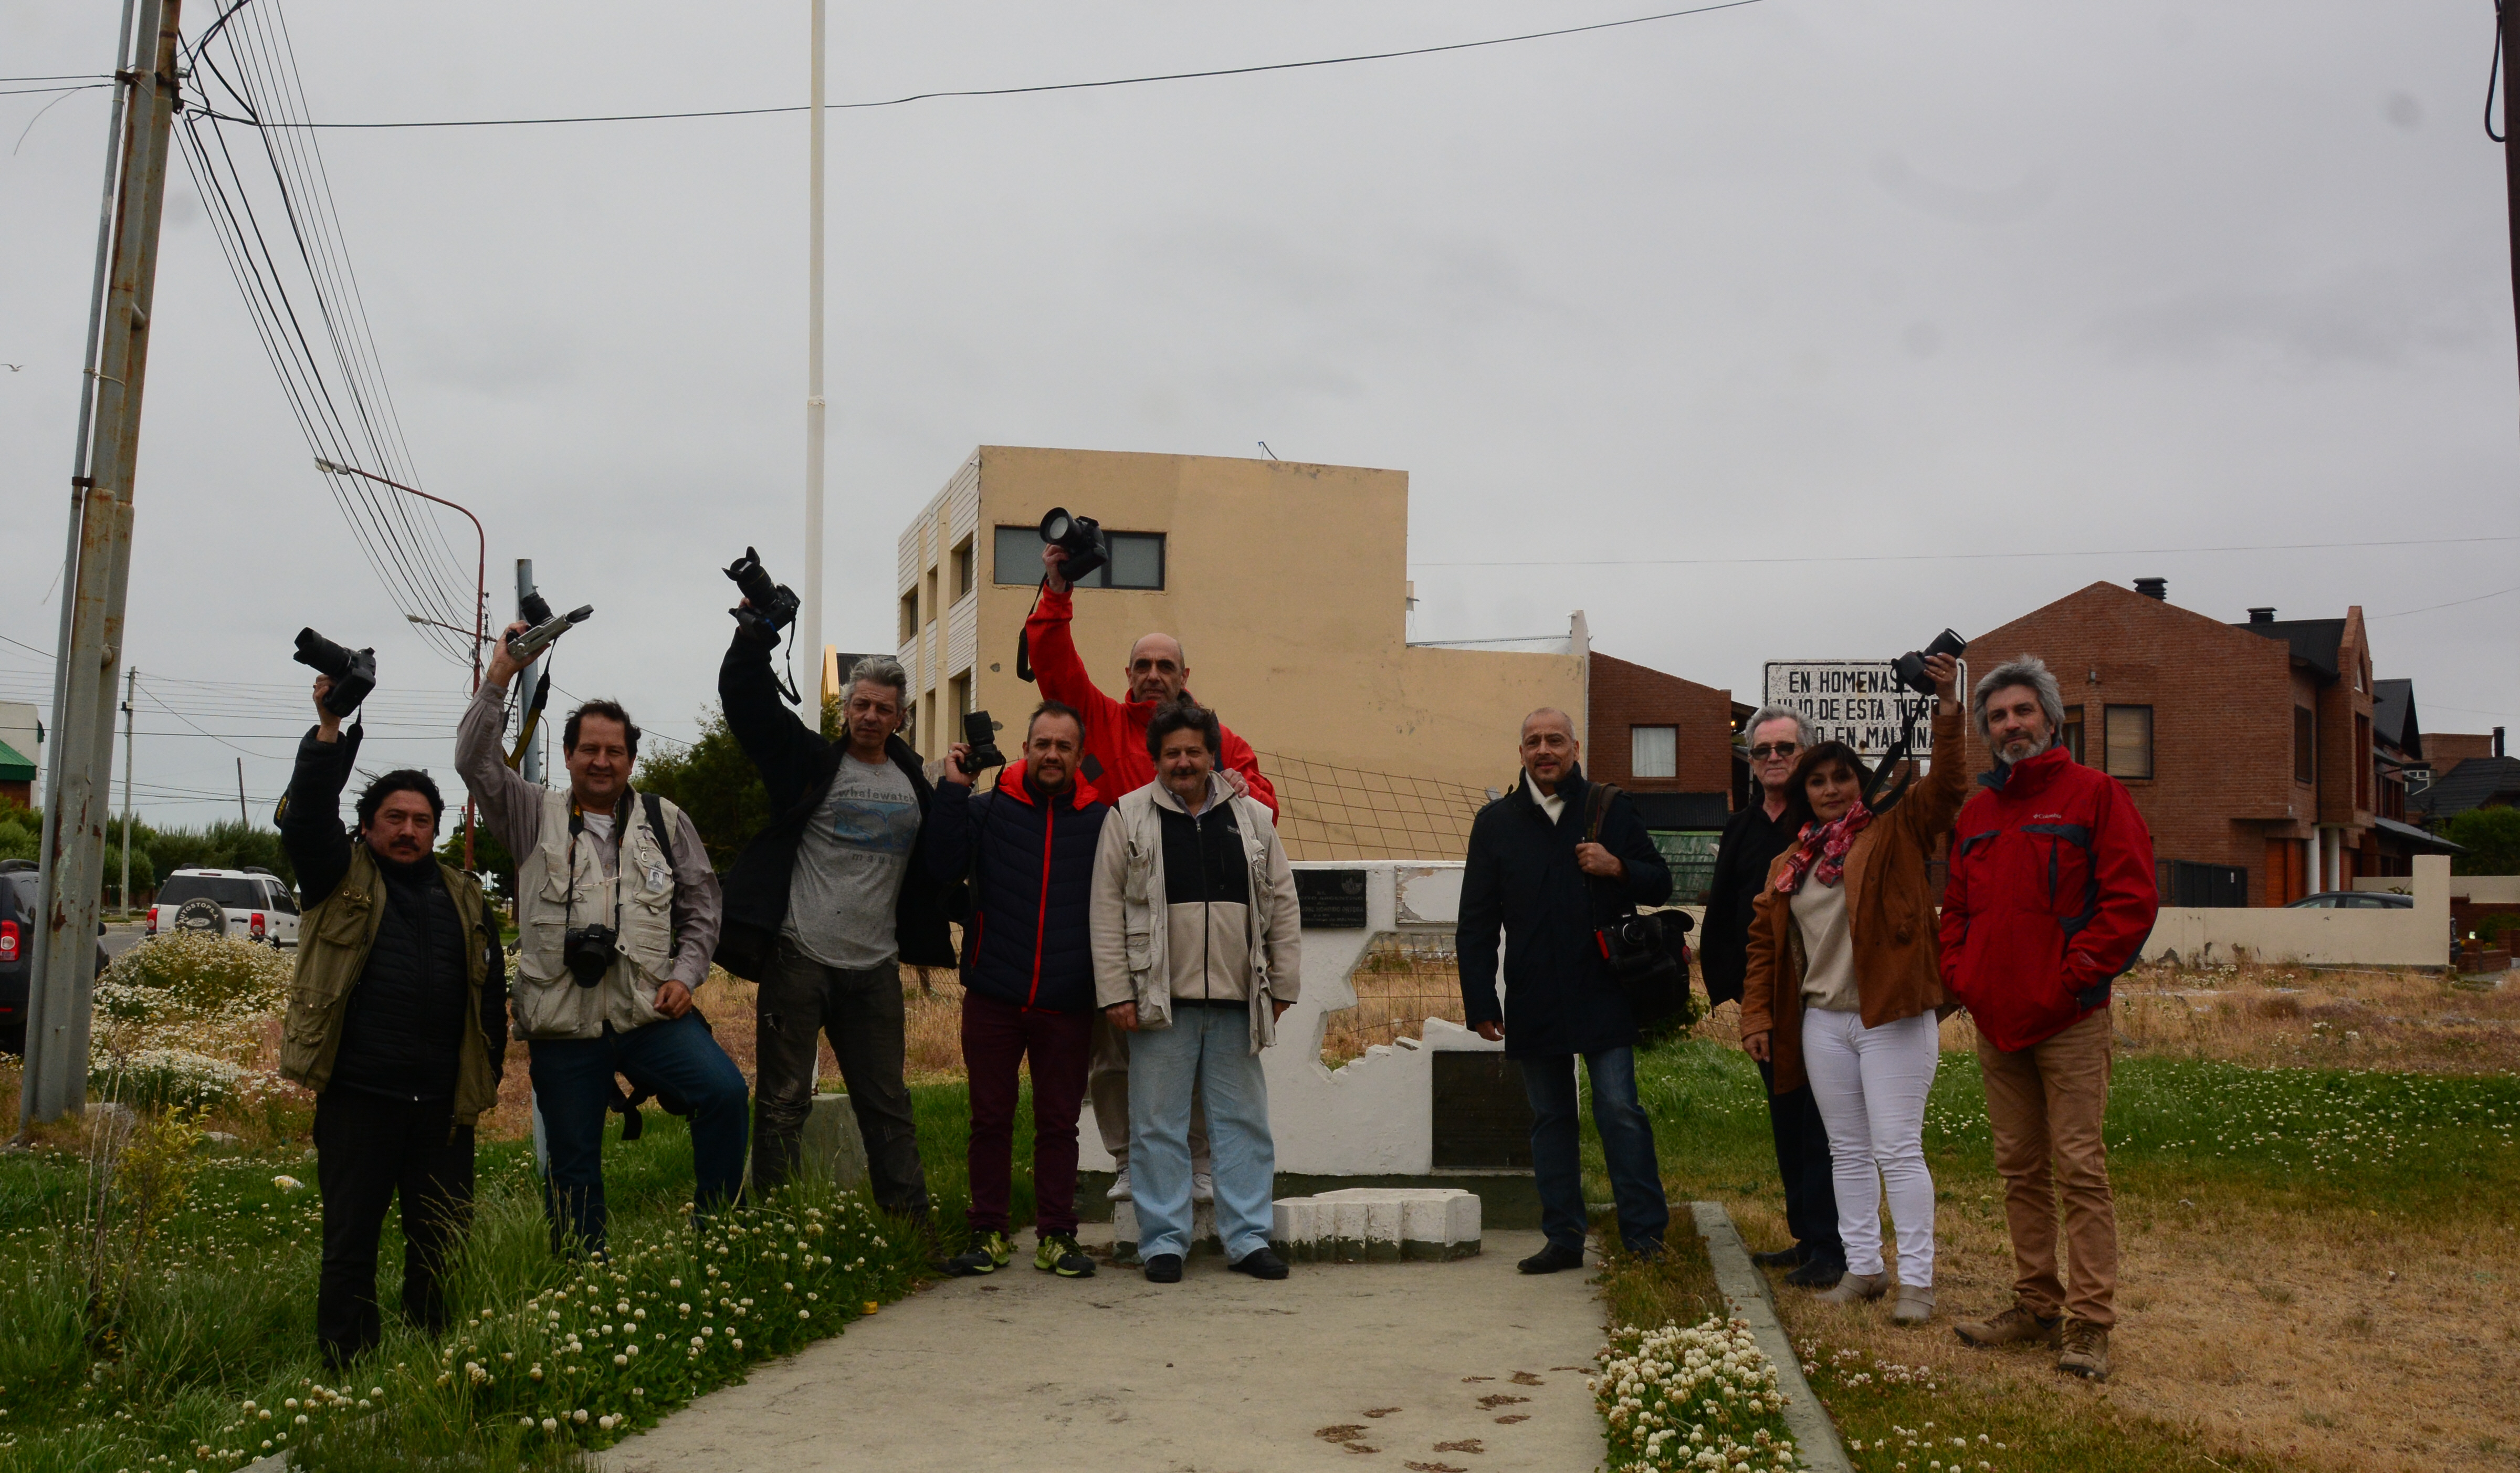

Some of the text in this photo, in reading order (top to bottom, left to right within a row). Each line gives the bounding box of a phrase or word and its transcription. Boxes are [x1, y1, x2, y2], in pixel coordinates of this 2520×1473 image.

[1789, 672, 1910, 693] EN HOMENA
[1819, 699, 1840, 719] DE
[1846, 698, 1885, 720] ESTA
[1893, 699, 1939, 720] TIER
[838, 787, 914, 802] whalewatch
[852, 853, 894, 865] maui
